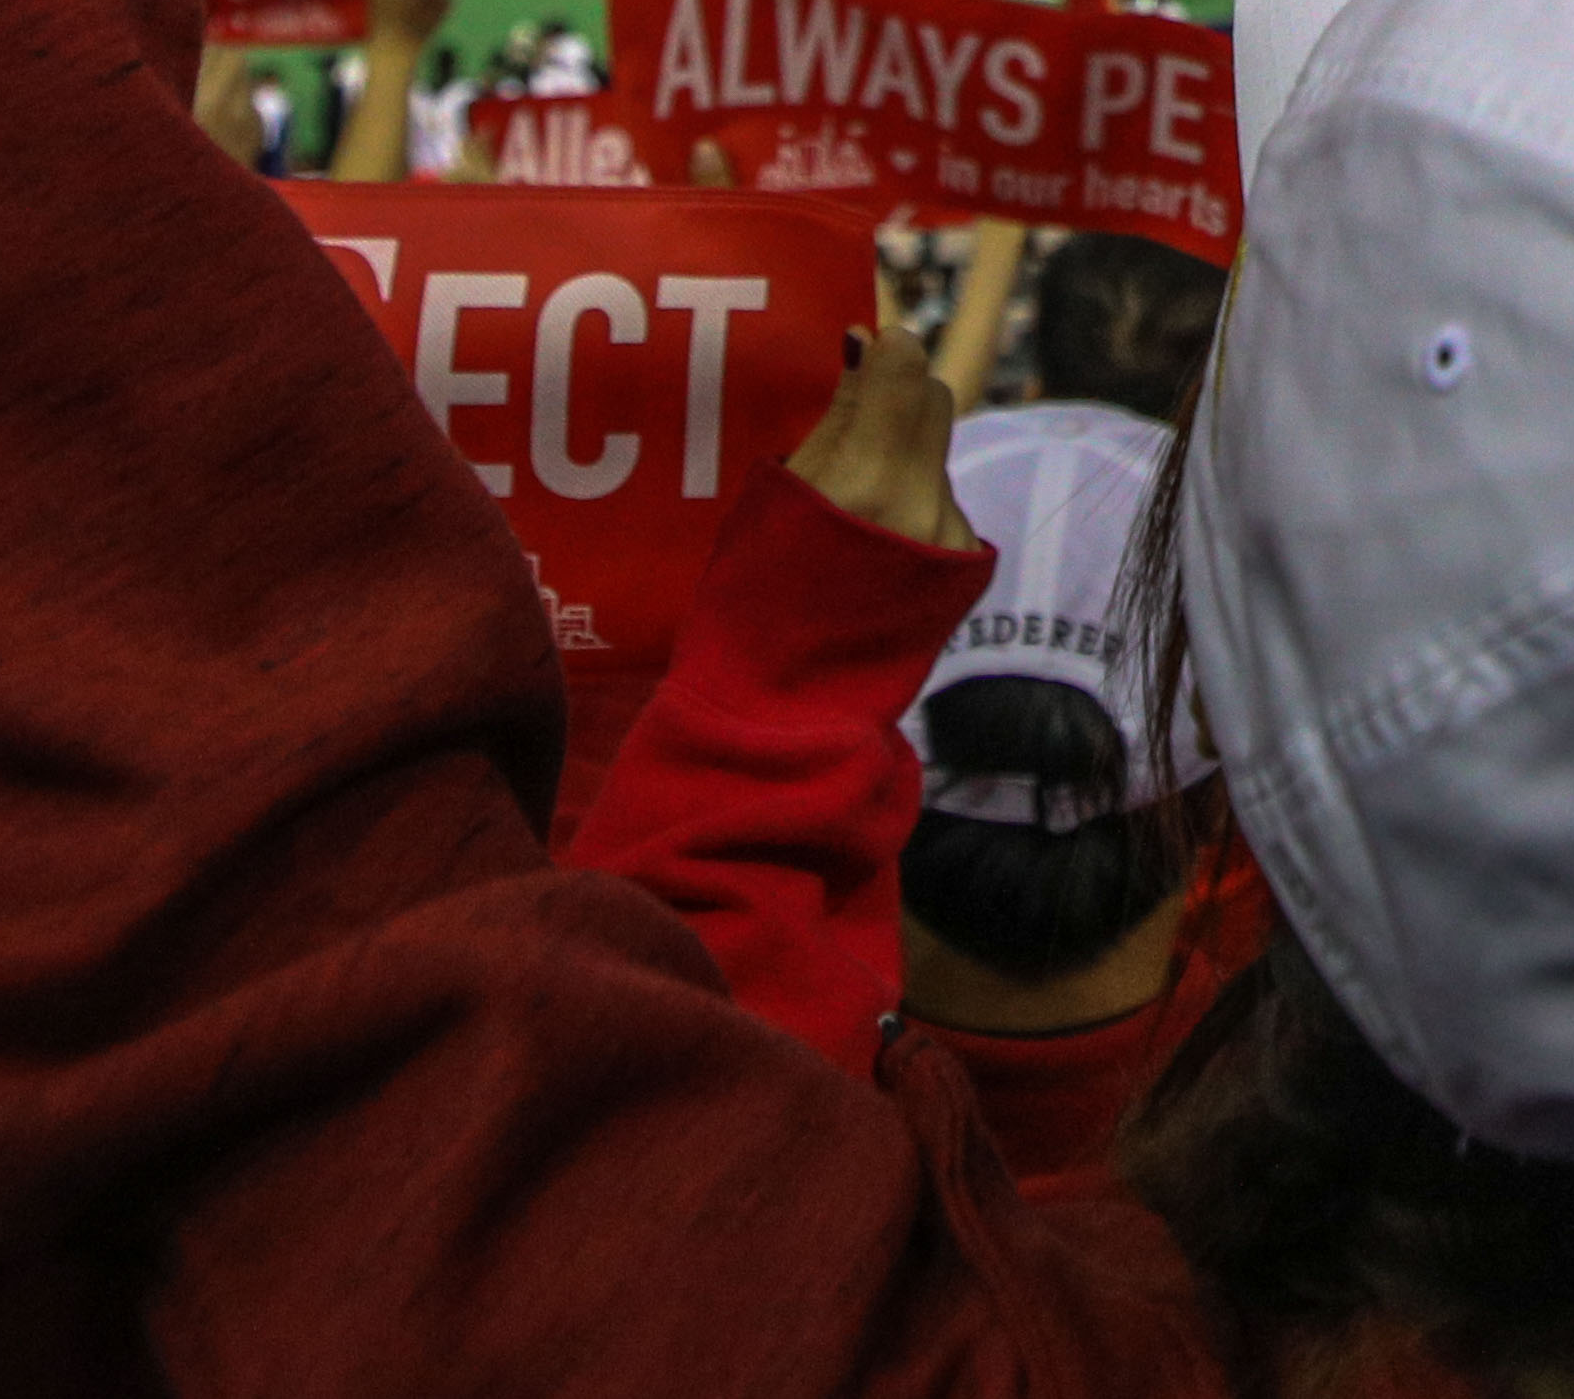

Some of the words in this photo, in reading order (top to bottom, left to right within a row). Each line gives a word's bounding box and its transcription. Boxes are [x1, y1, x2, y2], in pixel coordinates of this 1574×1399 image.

[936, 142, 982, 198] in
[990, 156, 1068, 214] our
[1082, 162, 1230, 240] hearts
